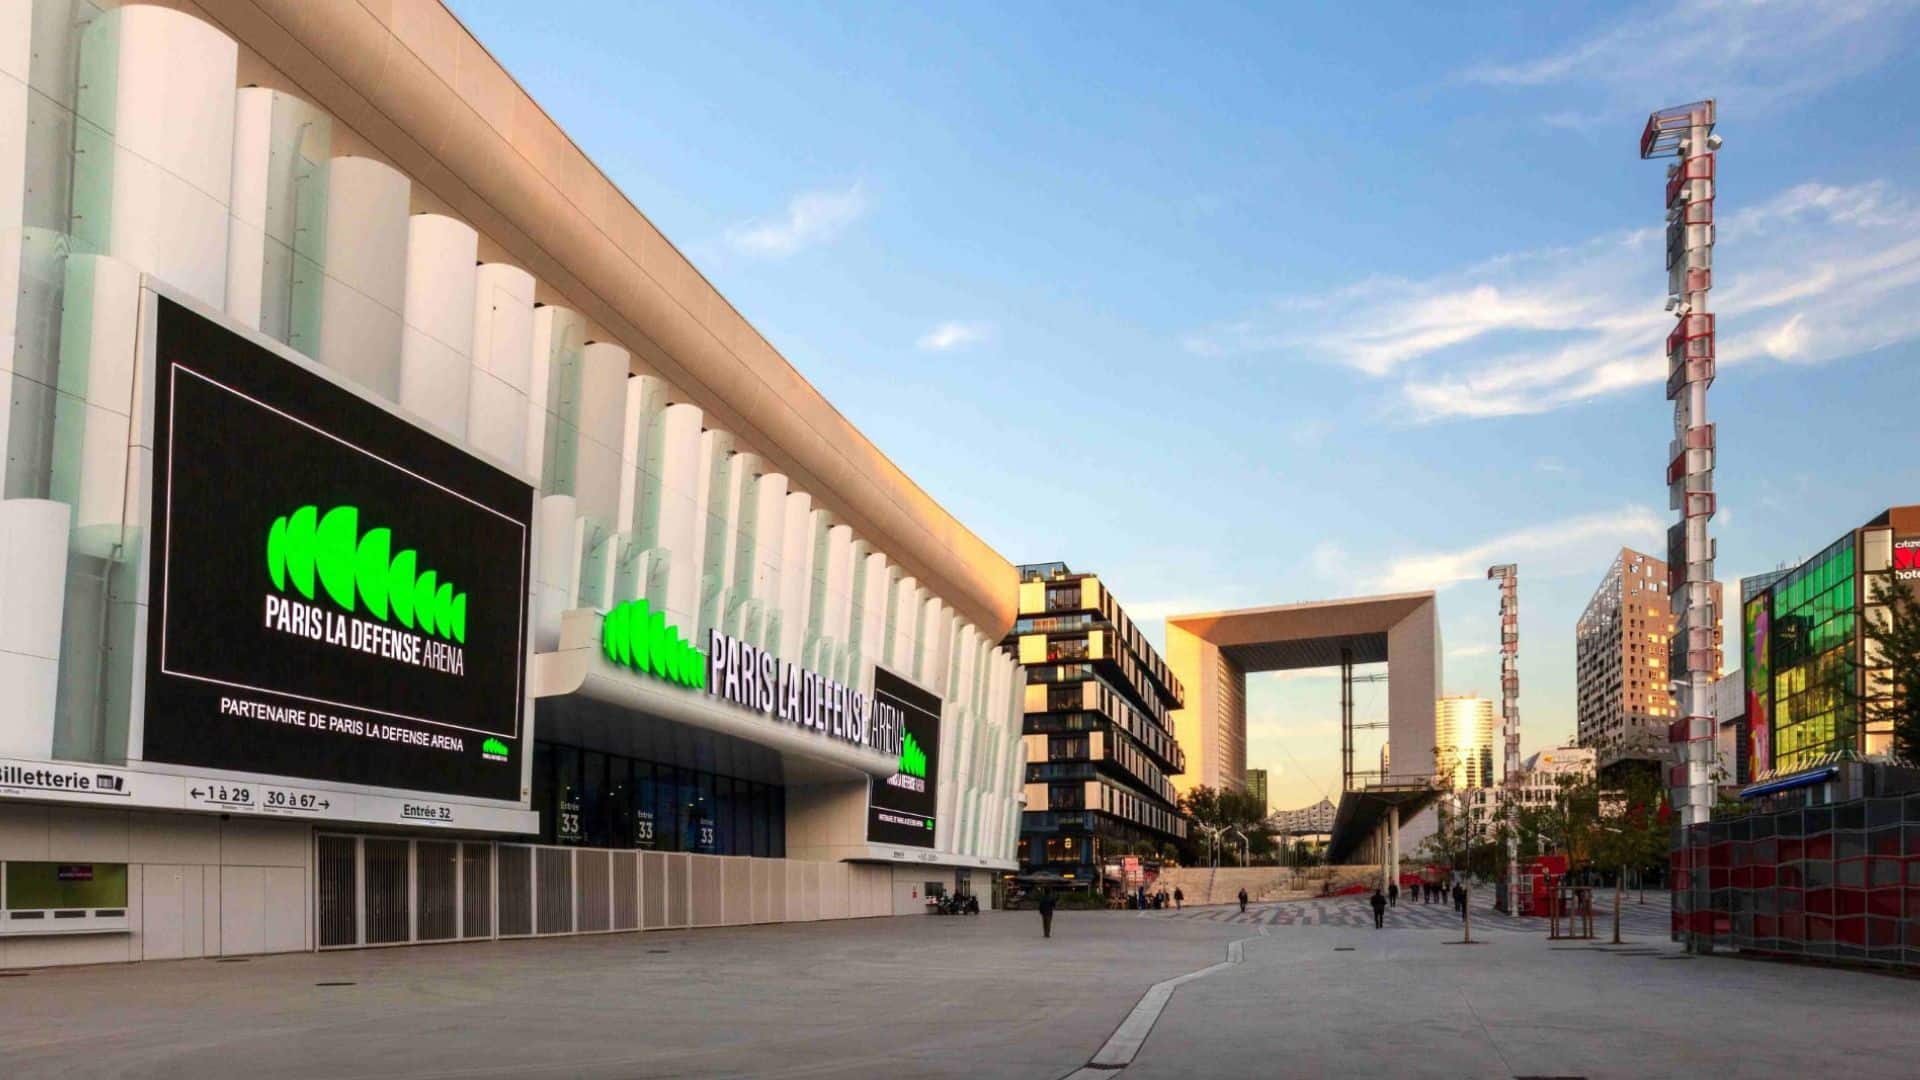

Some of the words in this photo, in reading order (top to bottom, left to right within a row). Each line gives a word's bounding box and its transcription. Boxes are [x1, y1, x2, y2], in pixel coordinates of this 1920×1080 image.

[265, 594, 322, 640] PARIS
[326, 611, 347, 647] LA
[350, 618, 421, 665] DEFENSE
[422, 639, 464, 677] ARENA
[709, 628, 773, 713] PARIS
[776, 658, 800, 723] LA
[802, 668, 868, 745] DEFENSE
[869, 699, 905, 756] ARENA
[220, 697, 306, 727] PARTENAIRE
[309, 712, 327, 729] DE
[328, 716, 364, 735] PARIS
[366, 722, 380, 738] LA
[382, 725, 430, 746] DEFENSE
[430, 734, 464, 752] ARENA
[0, 766, 90, 789] illetterie
[208, 785, 215, 799] 1
[219, 786, 227, 801] à
[232, 788, 250, 802] 29
[267, 791, 285, 805] 30
[289, 793, 297, 806] à
[300, 794, 316, 808] 67
[403, 804, 436, 818] Entrée
[439, 807, 451, 819] 32
[562, 813, 579, 833] 33
[639, 822, 653, 839] 33
[701, 828, 714, 844] 33
